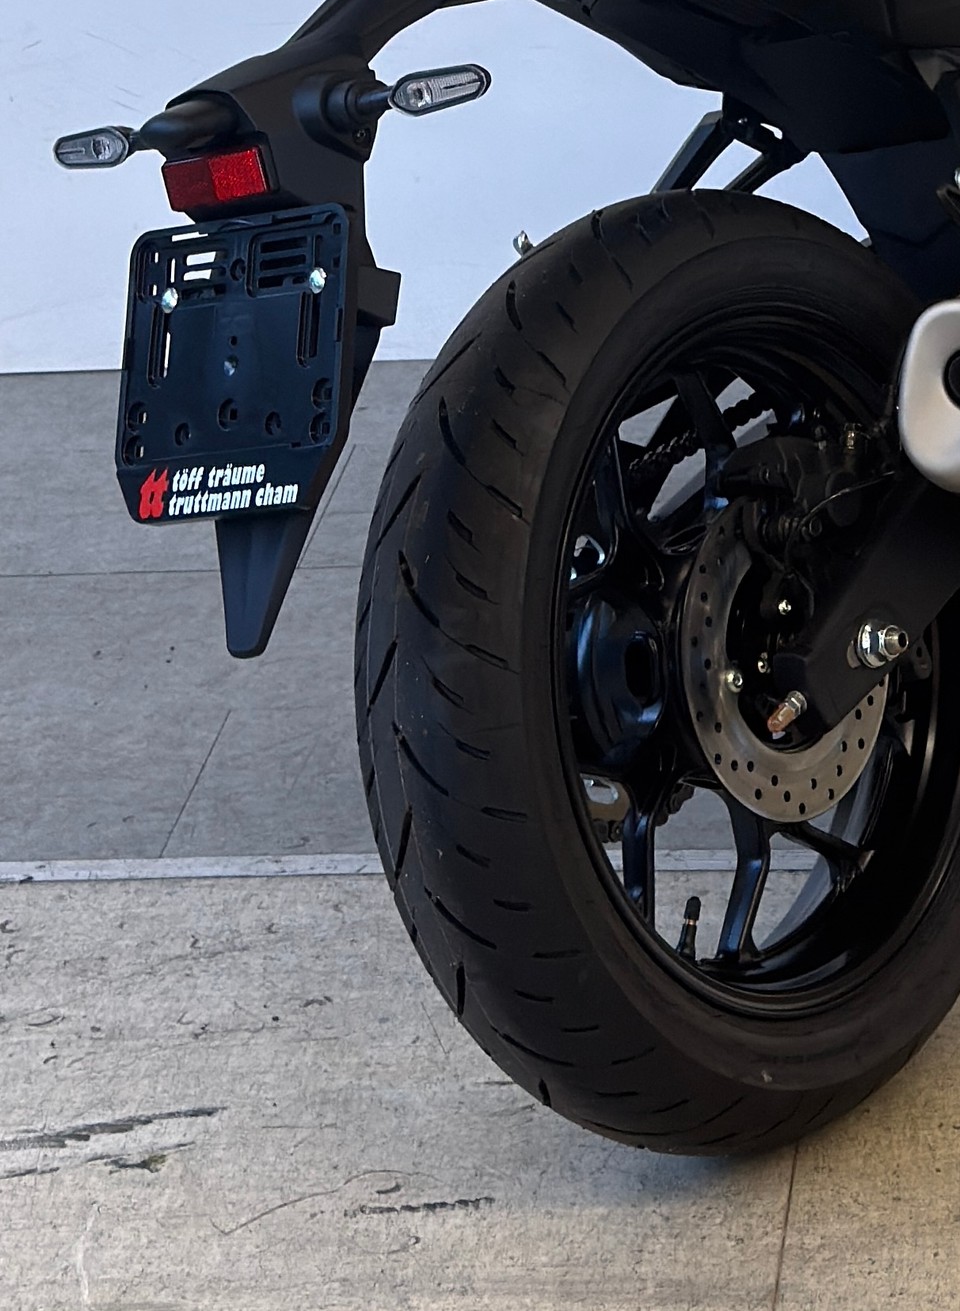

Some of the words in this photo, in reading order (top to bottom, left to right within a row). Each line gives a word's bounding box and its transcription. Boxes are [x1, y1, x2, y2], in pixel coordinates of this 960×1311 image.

[172, 466, 205, 492] töff
[207, 463, 266, 488] träume
[168, 489, 252, 516] truttmann
[255, 482, 299, 507] cham
